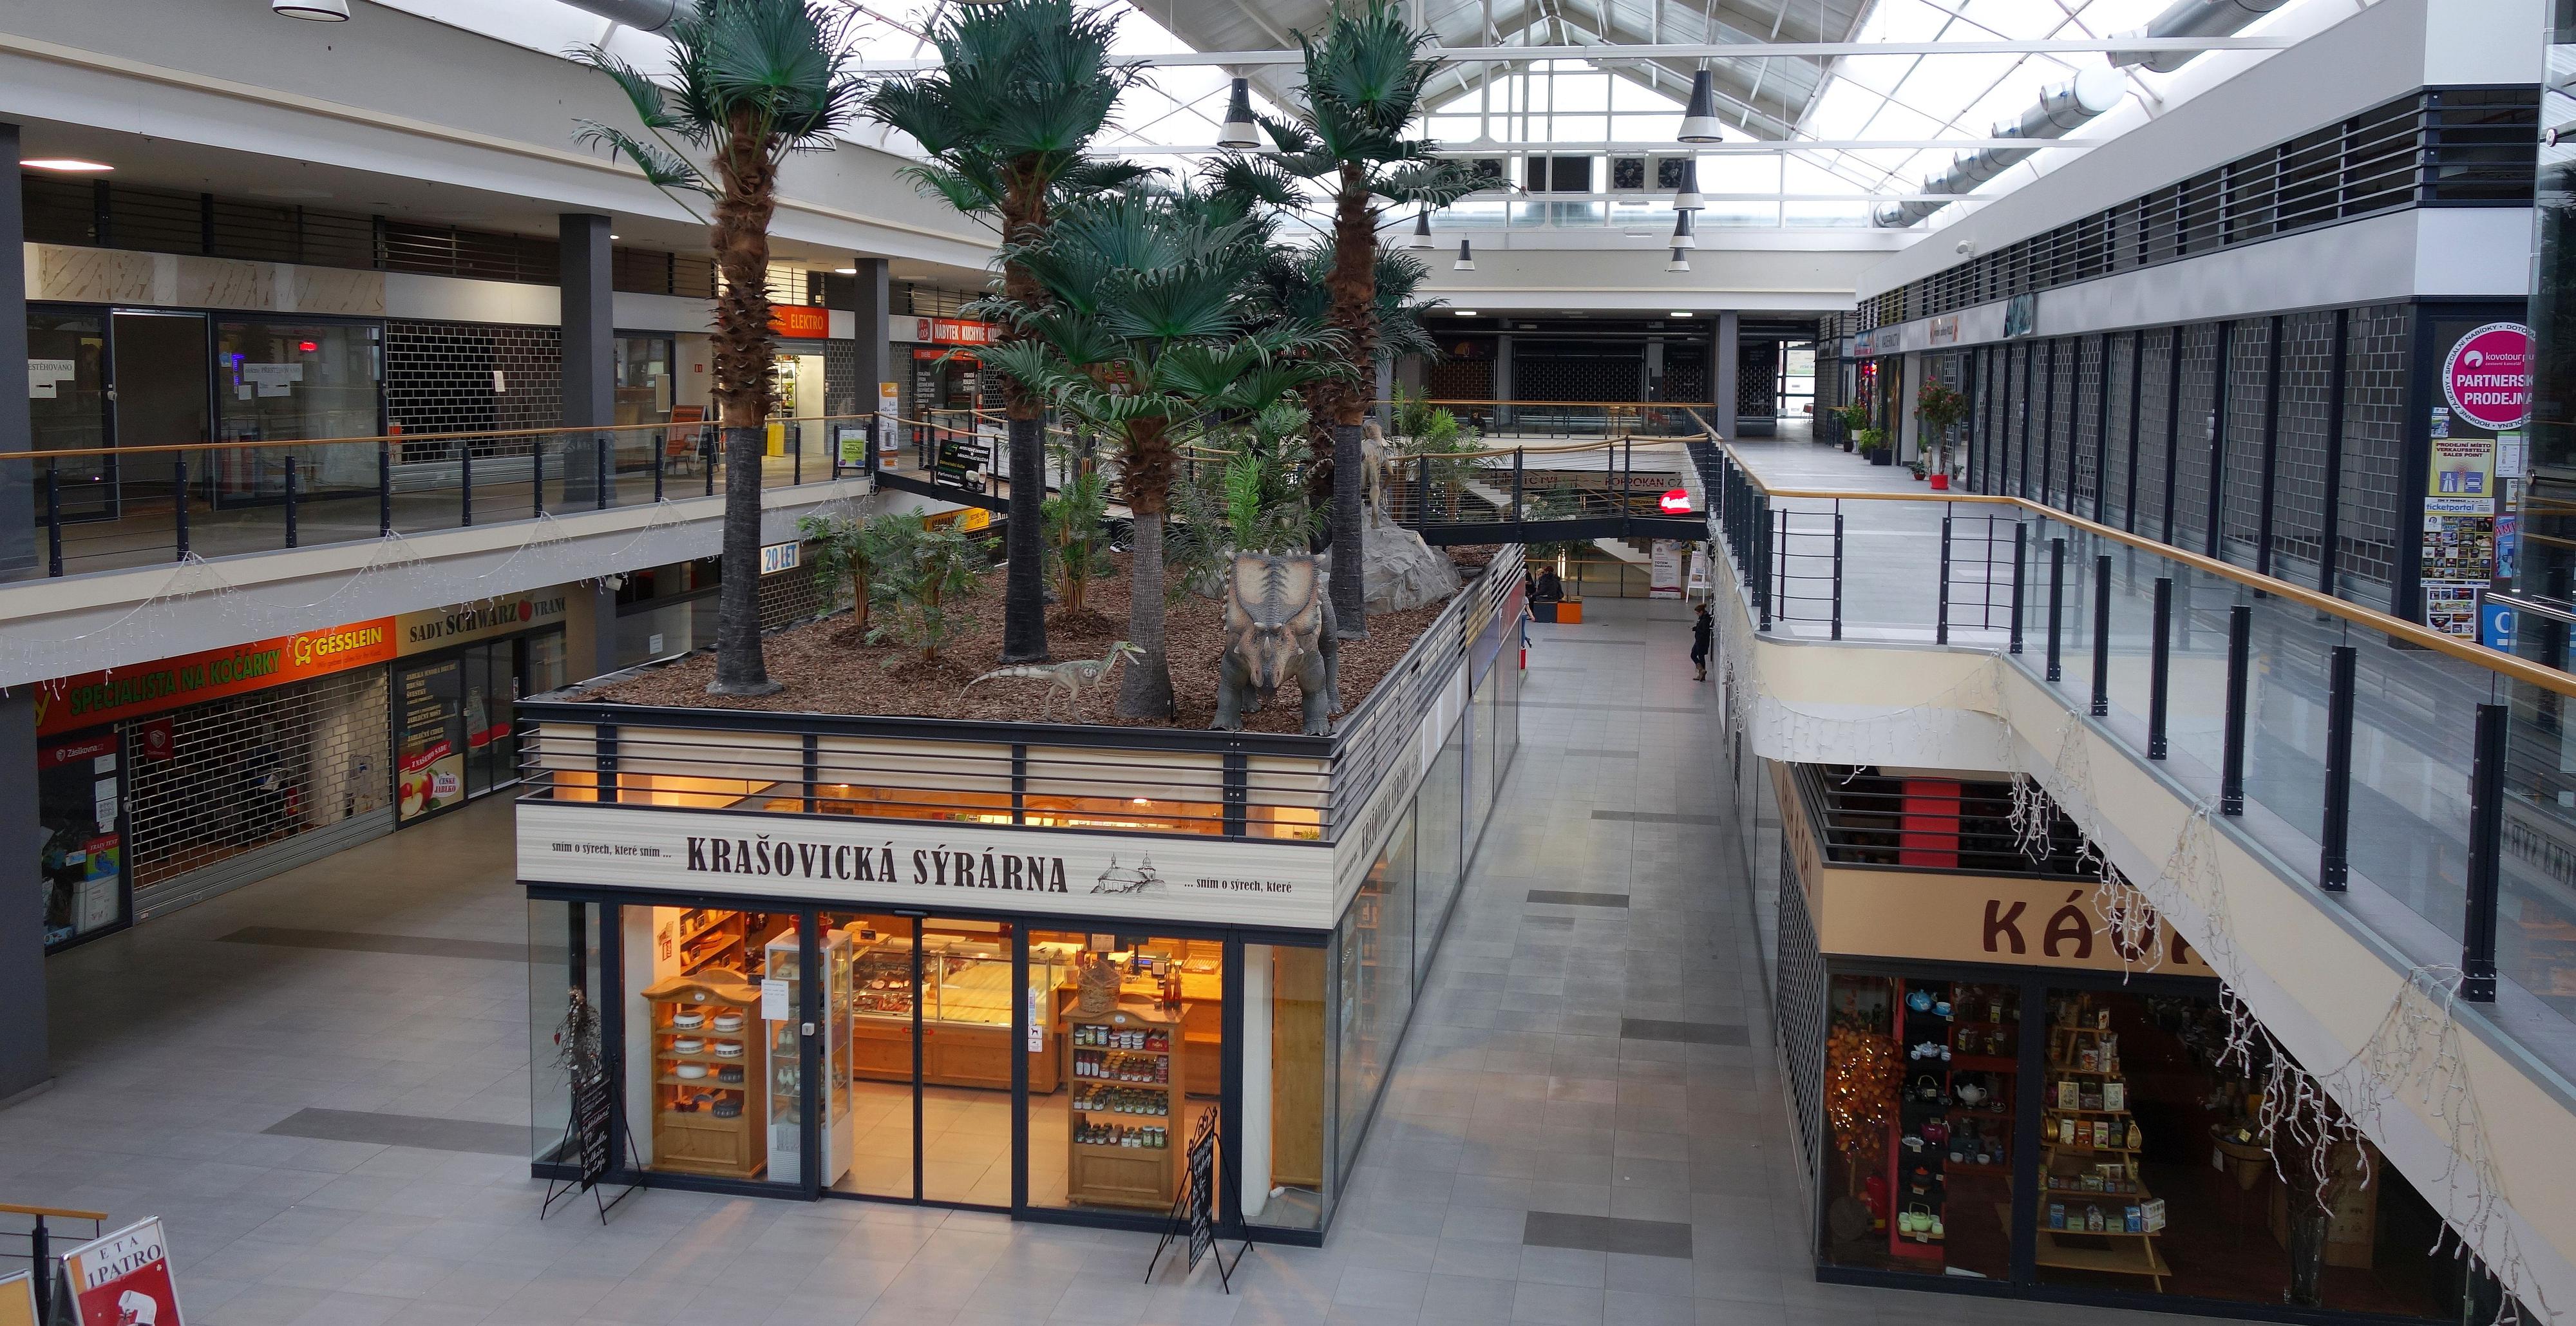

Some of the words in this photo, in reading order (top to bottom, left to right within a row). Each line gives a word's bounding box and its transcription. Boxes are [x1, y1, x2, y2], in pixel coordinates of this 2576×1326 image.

[791, 314, 823, 330] ELEKTRO
[934, 320, 959, 340] NÁBYTEK
[2465, 325, 2497, 342] NABÍDKY
[2445, 341, 2467, 374] SPECIÁLNÍ
[2486, 352, 2521, 361] kovotour
[766, 547, 778, 571] 20
[781, 544, 796, 568] LET
[410, 621, 443, 643] SADY
[446, 602, 518, 636] SCHWARZ
[316, 626, 382, 656] GESSLEIN
[70, 670, 176, 715] SPECIALISTA
[181, 664, 205, 692] NA
[209, 648, 281, 685] KOČÁRKY
[435, 744, 448, 755] SADU
[439, 776, 455, 784] ČESKÉ
[552, 841, 572, 852] sním
[575, 844, 580, 853] o
[582, 843, 612, 856] sýrech,
[615, 845, 638, 856] které
[640, 846, 659, 857] sním
[687, 833, 898, 884] KRAŠOVICKÁ
[913, 844, 1069, 893] SÝRÁRNA
[1197, 877, 1218, 889] sním
[1222, 880, 1227, 889] o
[1231, 878, 1263, 893] sýrech,
[1266, 881, 1292, 893] které
[99, 1236, 138, 1260] ETA
